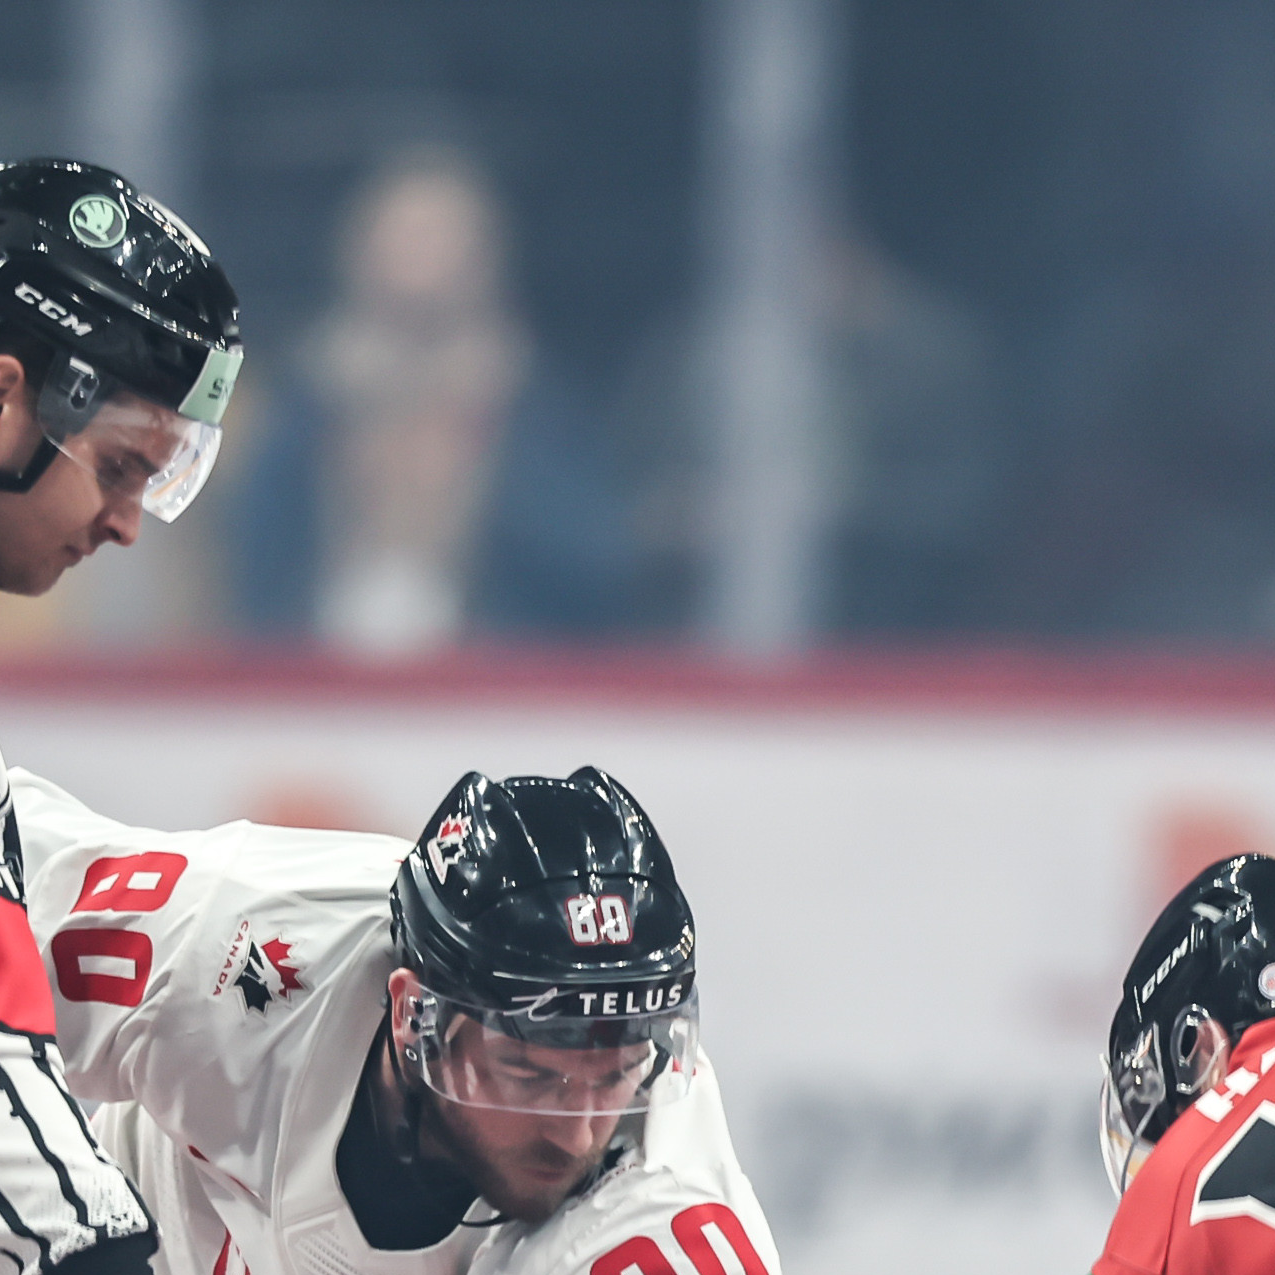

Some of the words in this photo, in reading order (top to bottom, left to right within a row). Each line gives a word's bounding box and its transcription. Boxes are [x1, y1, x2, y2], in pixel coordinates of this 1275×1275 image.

[14, 281, 92, 336] CCM
[51, 850, 189, 1008] 80
[564, 895, 634, 946] 80
[211, 919, 250, 997] CANADA
[1141, 935, 1189, 1004] CCM
[579, 983, 683, 1016] TELUS
